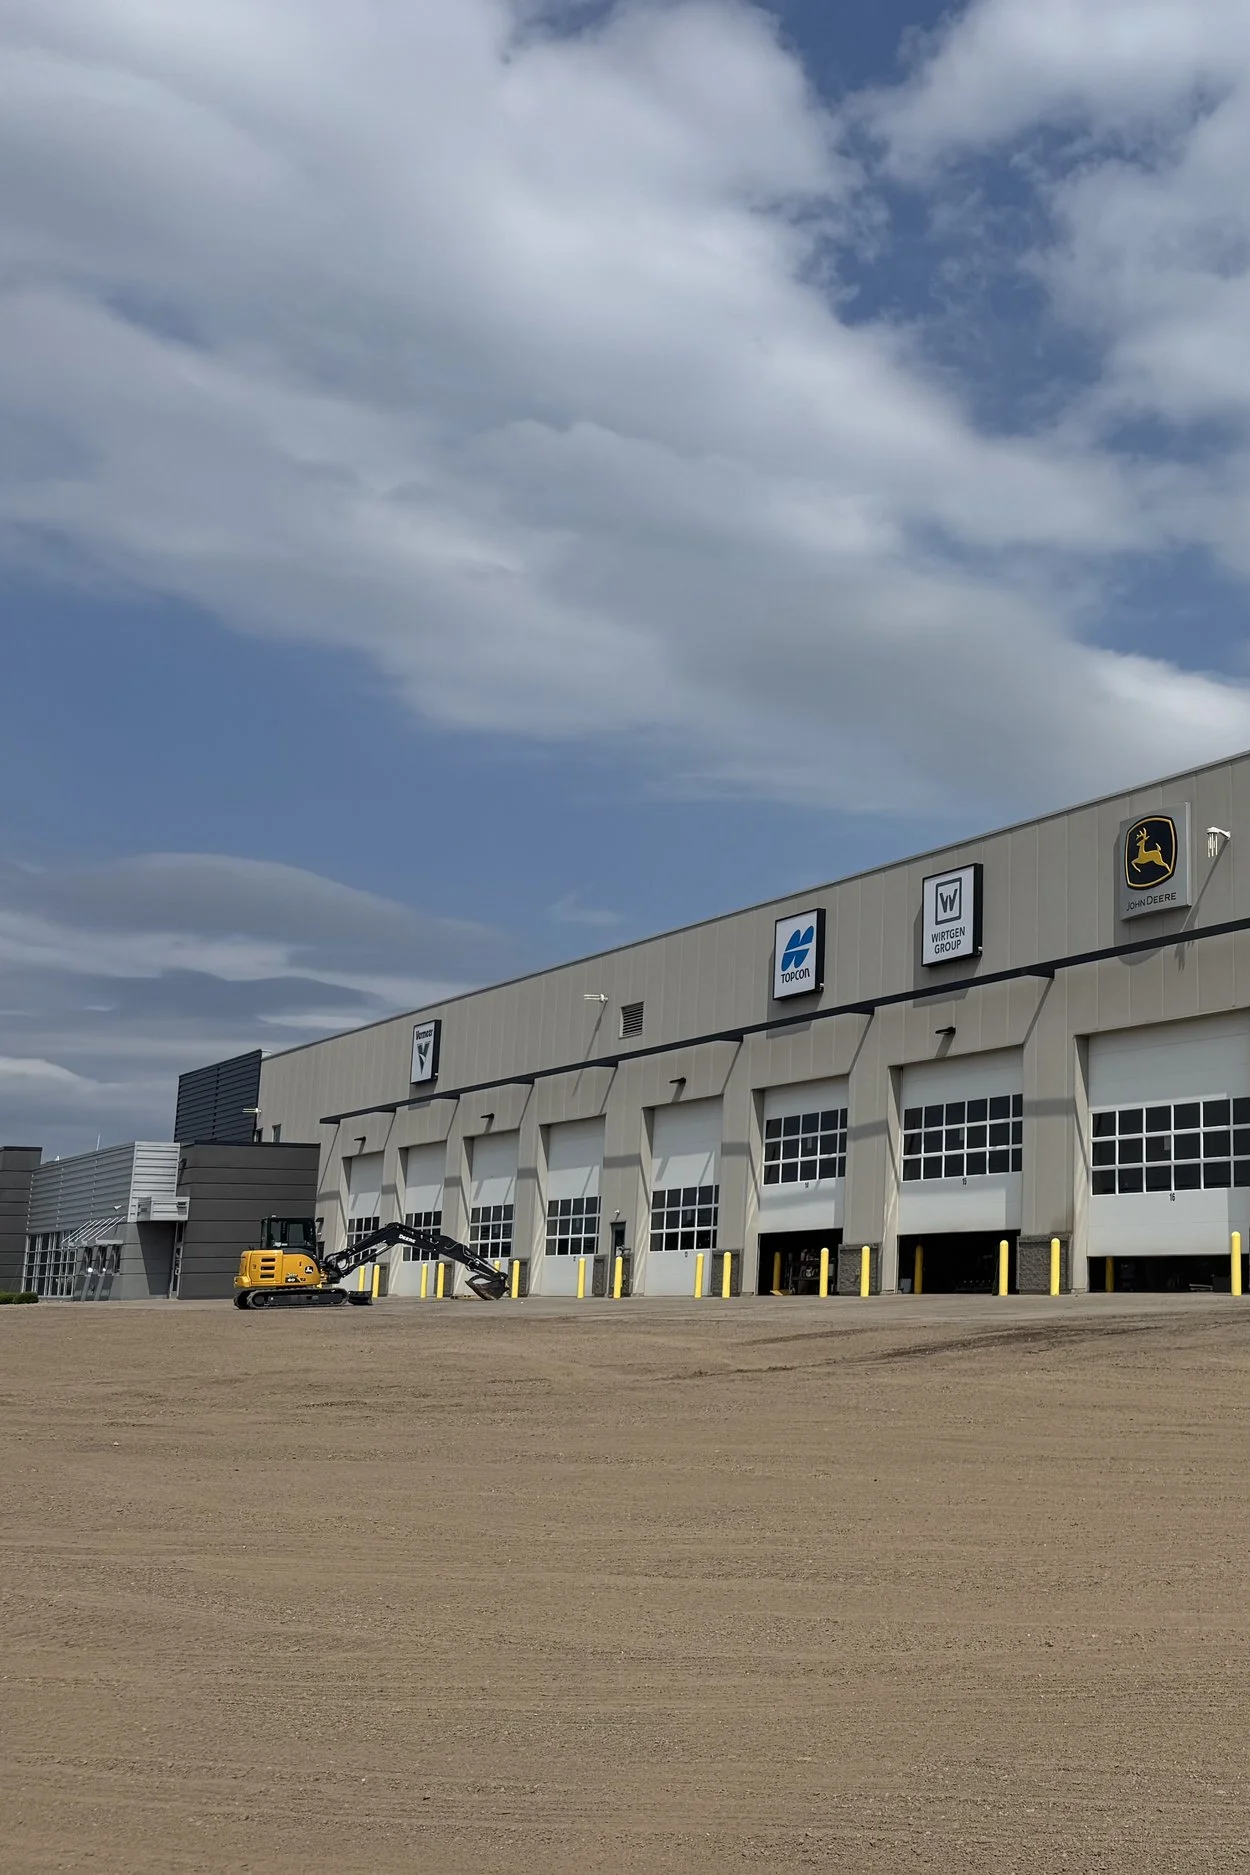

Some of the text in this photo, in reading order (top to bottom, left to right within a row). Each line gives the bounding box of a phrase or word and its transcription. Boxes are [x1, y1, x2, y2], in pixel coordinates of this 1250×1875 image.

[1126, 892, 1177, 911] JOHN DEERE
[931, 926, 966, 943] WIRTGEN
[934, 939, 962, 955] GROUP
[780, 967, 811, 984] TOPCON
[1169, 1192, 1176, 1202] 16
[398, 1233, 416, 1244] DEERE
